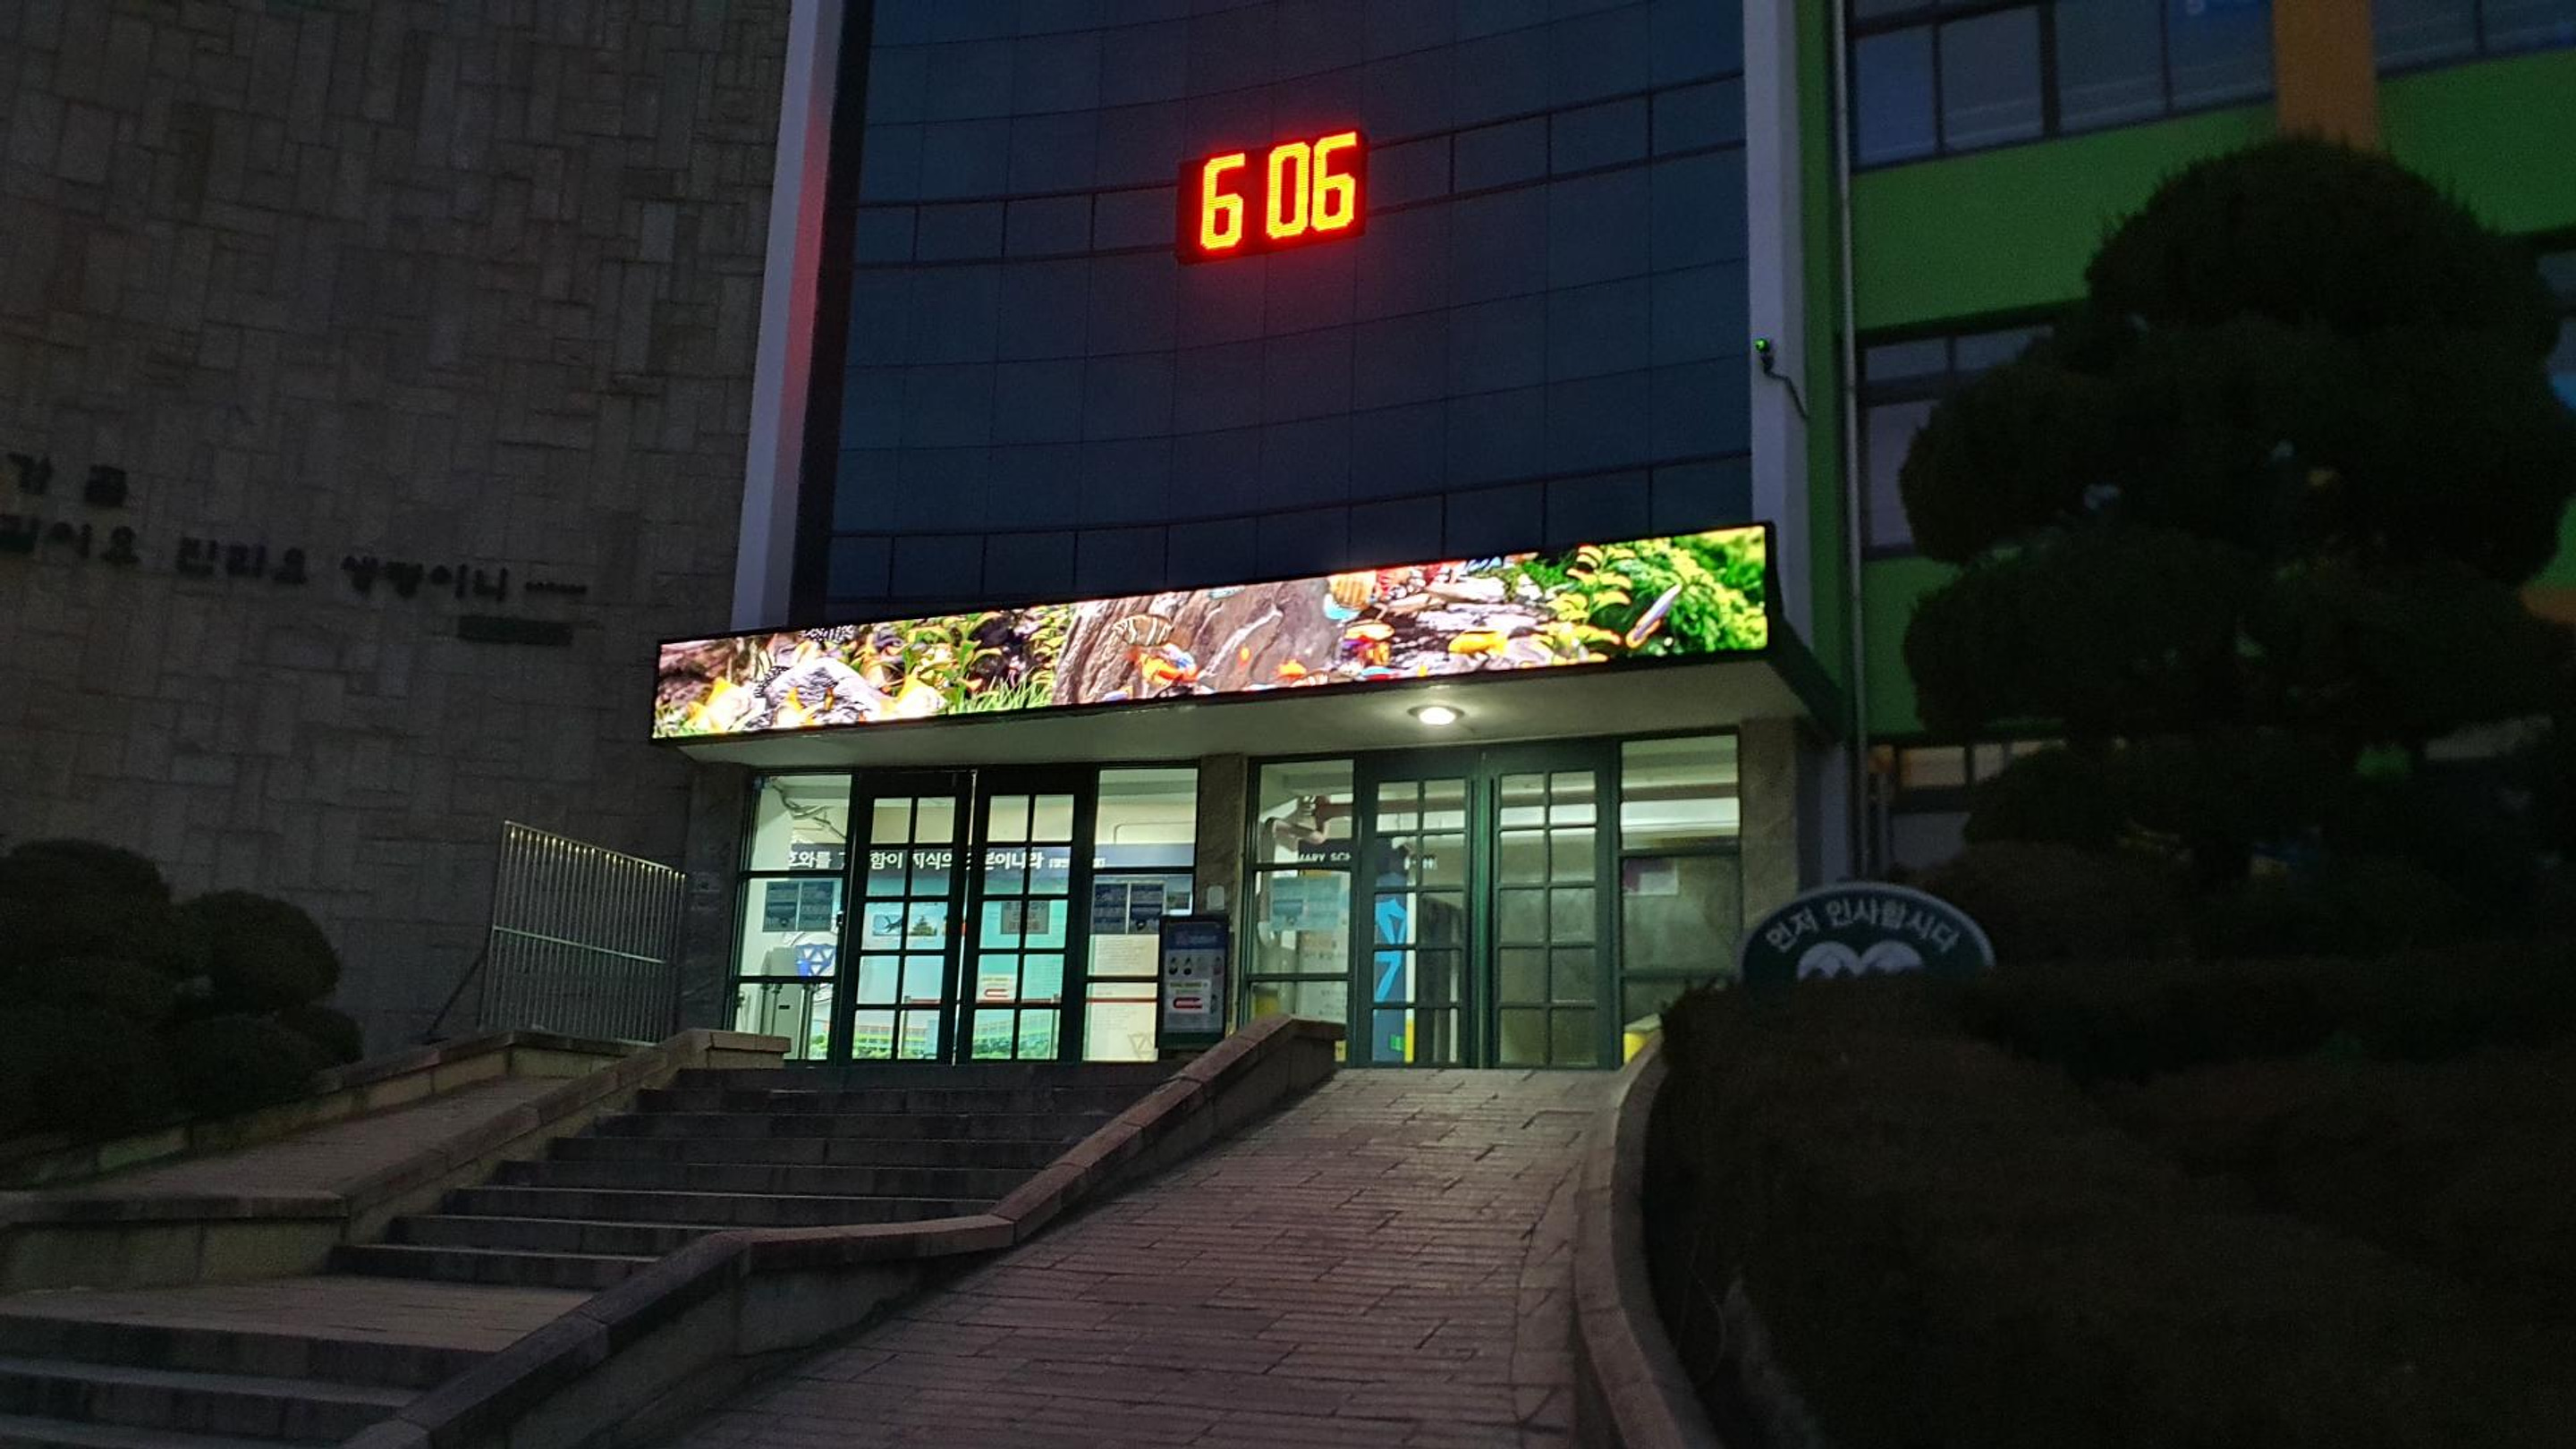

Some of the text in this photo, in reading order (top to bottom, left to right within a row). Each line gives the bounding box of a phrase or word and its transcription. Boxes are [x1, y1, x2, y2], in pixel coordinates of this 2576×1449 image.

[1200, 131, 1358, 250] 6 06
[788, 851, 832, 869] 호와를
[1825, 897, 1961, 953] 인사합시다
